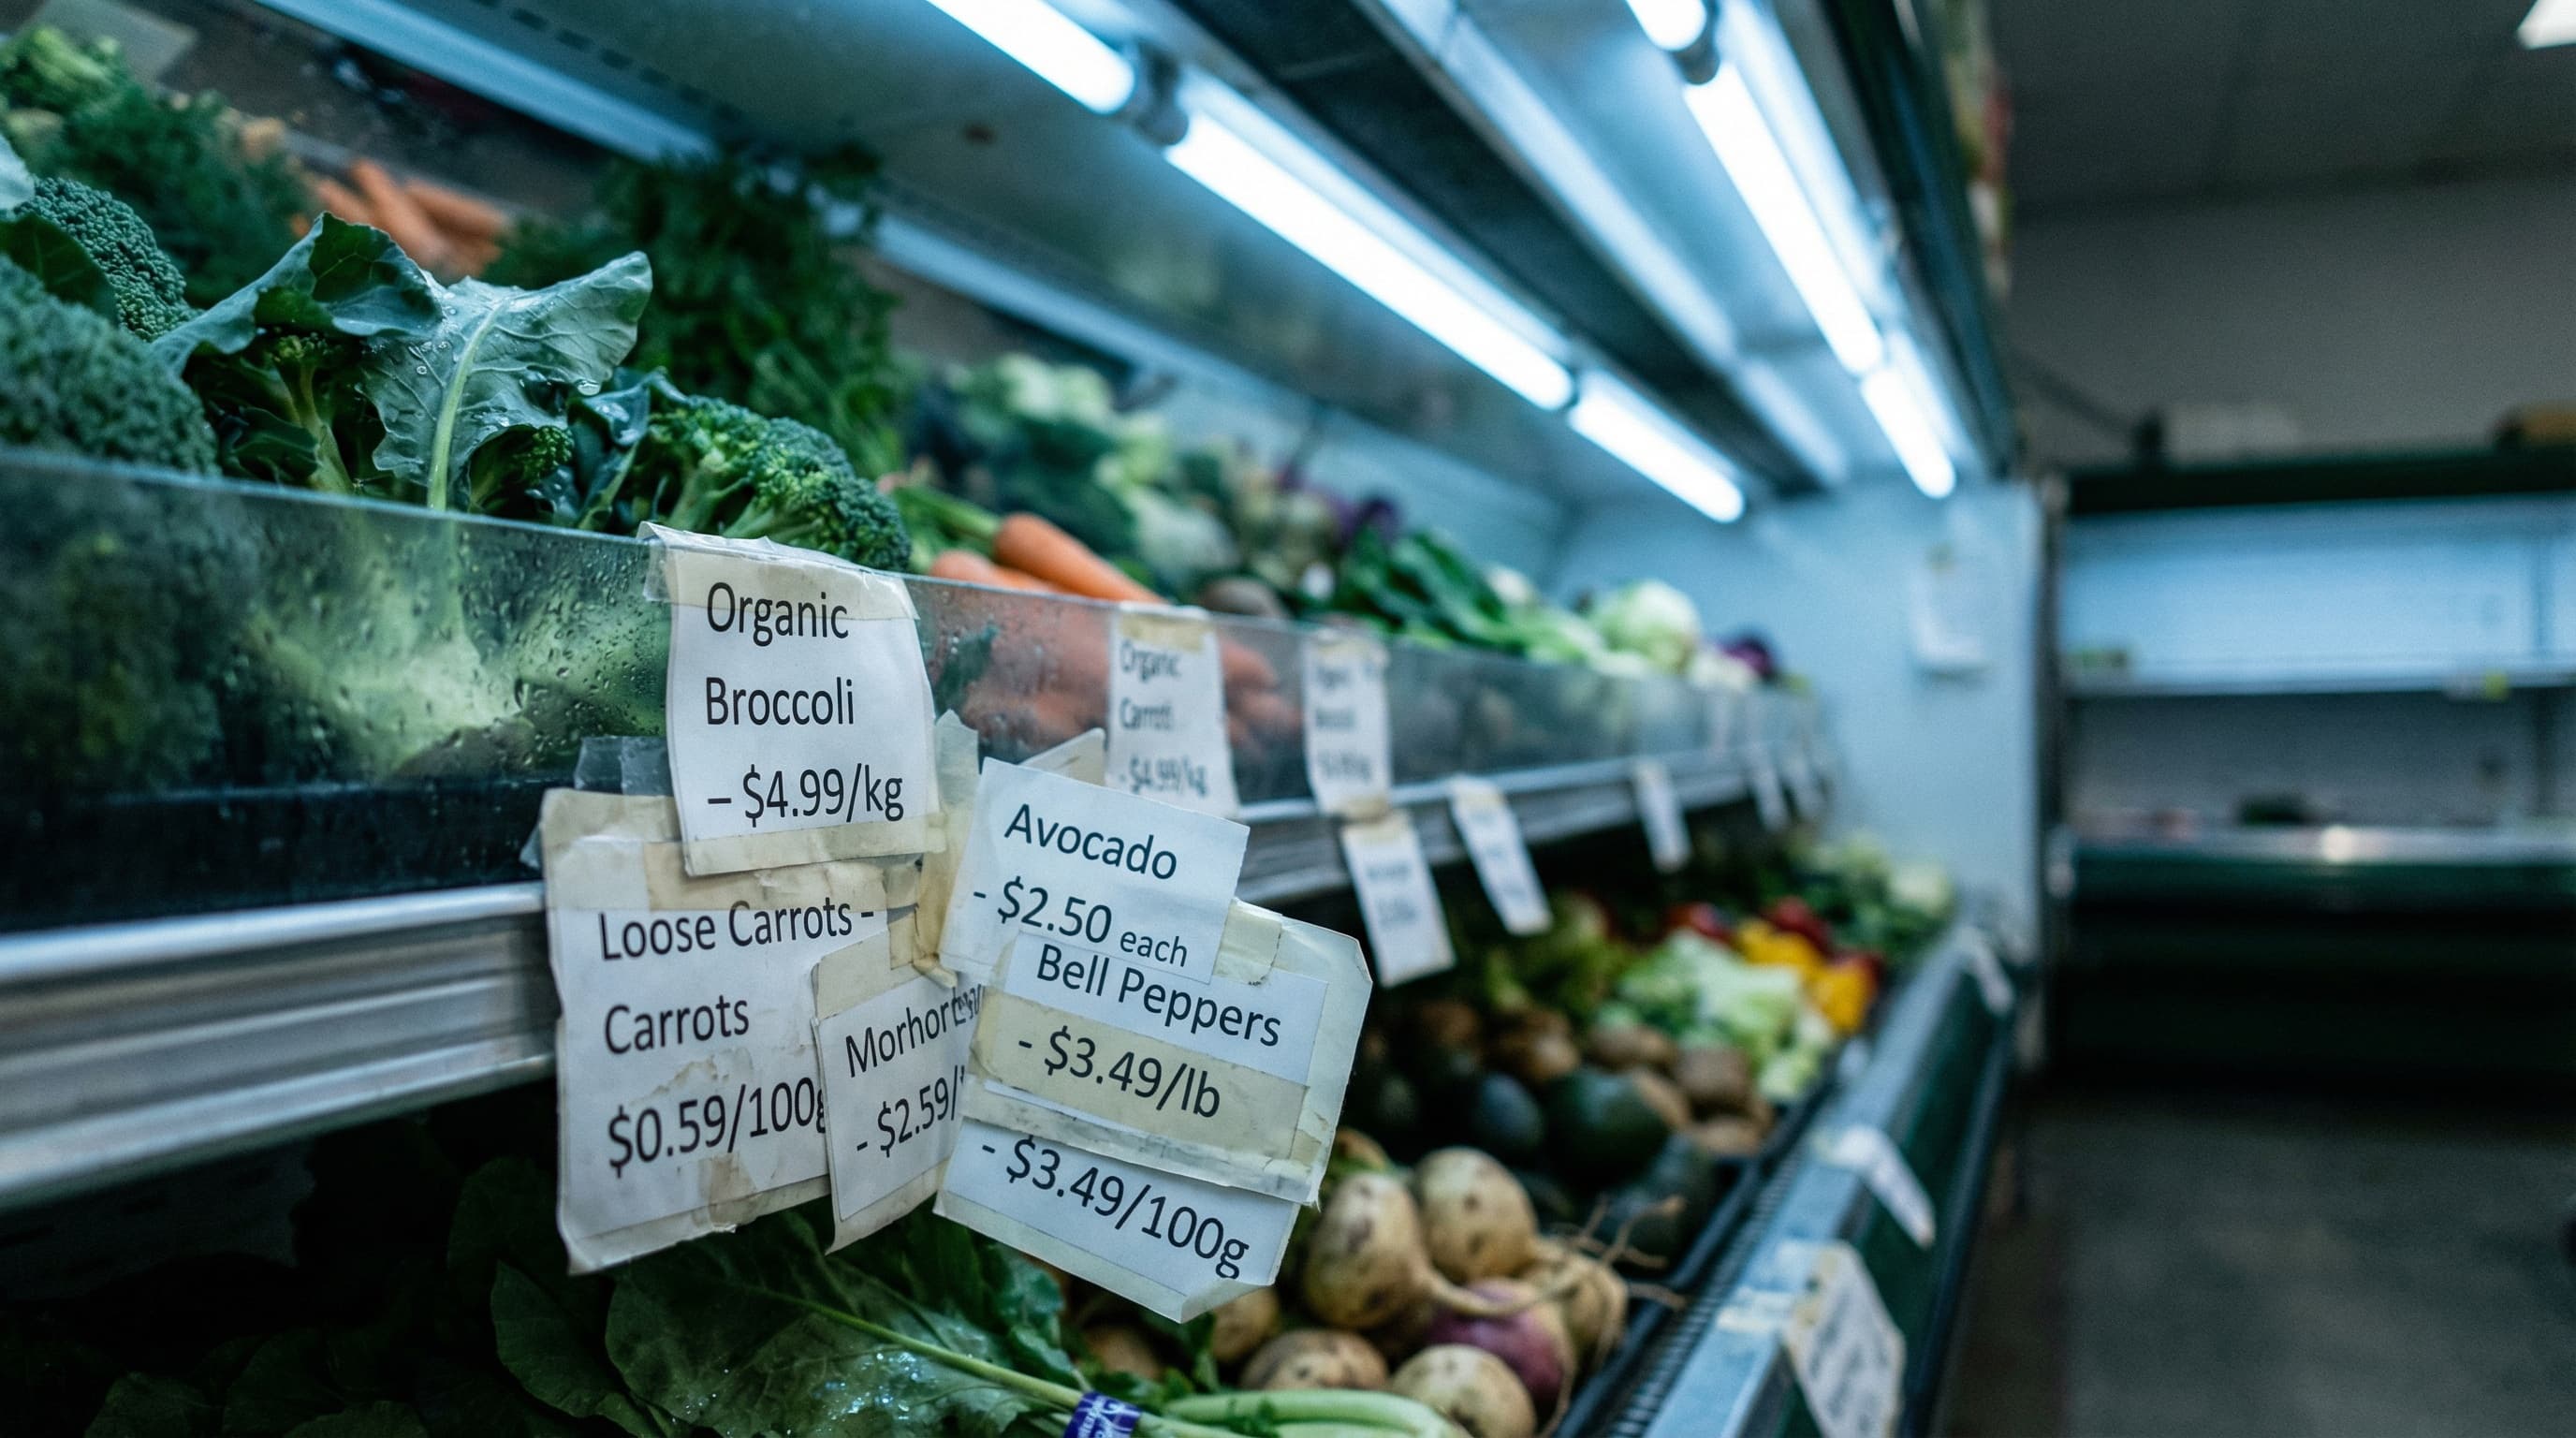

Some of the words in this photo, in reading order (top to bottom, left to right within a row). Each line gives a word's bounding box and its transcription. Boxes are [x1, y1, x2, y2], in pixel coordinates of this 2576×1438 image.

[708, 582, 849, 647] Organic
[707, 677, 854, 726] Broccoli
[743, 763, 904, 828] $4.99/kg
[1004, 803, 1178, 880] Avocado
[599, 912, 716, 961] Loose
[728, 896, 854, 947] Carrots
[997, 876, 1112, 944] $2.50
[1120, 931, 1188, 967] each
[604, 995, 750, 1054] Carrots
[1037, 944, 1110, 996] Bell
[1118, 967, 1281, 1047] Peppers
[1044, 1025, 1221, 1118] $3.49/lb
[877, 1064, 966, 1158] $2.59/
[1005, 1135, 1250, 1280] $3.49/100g
